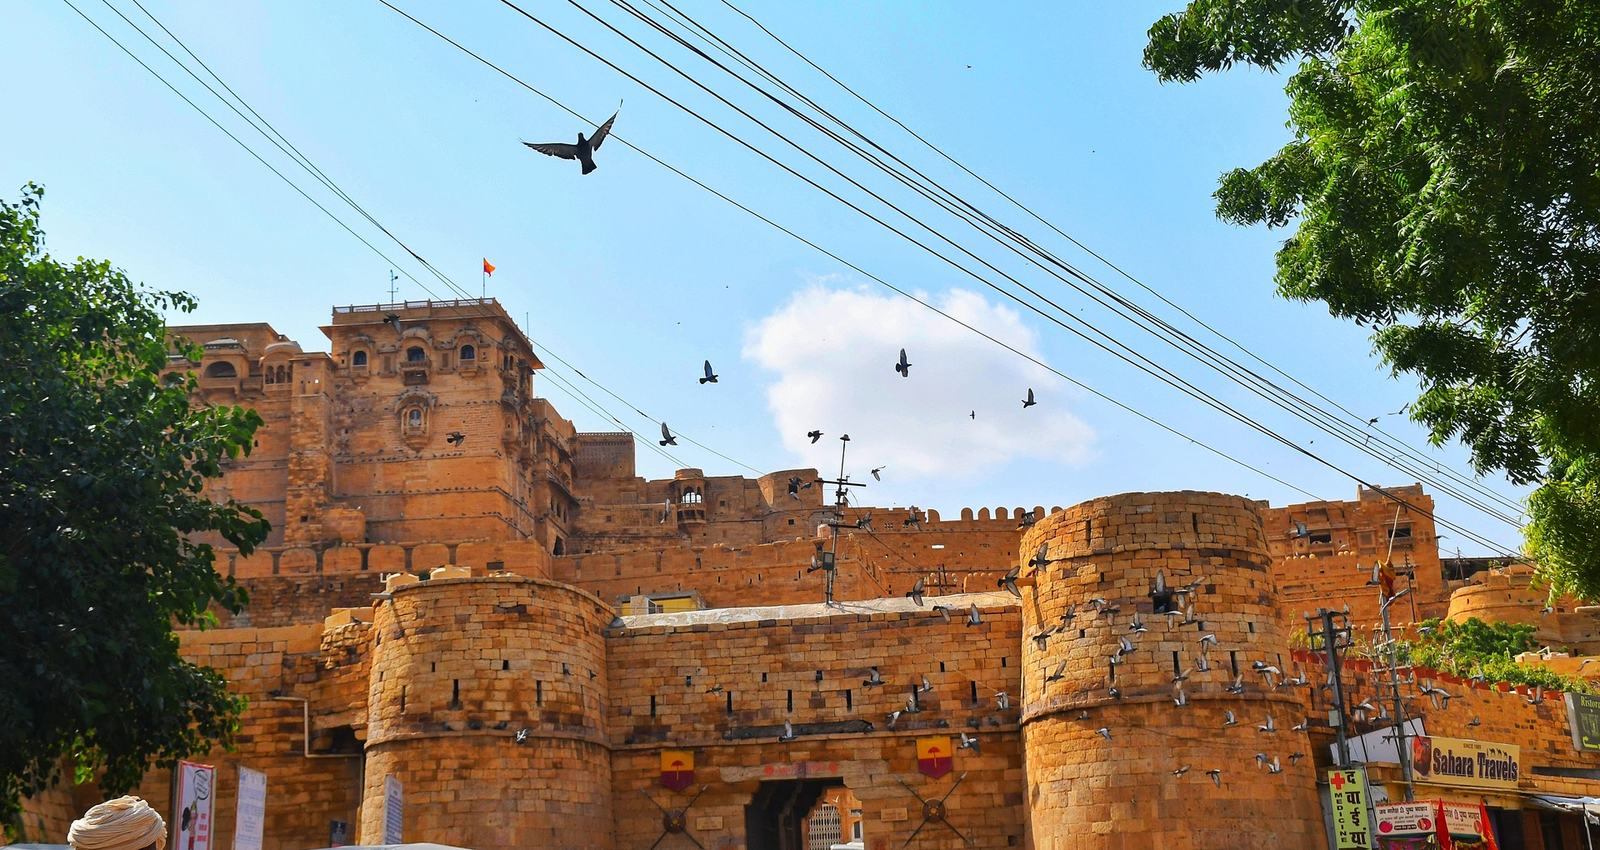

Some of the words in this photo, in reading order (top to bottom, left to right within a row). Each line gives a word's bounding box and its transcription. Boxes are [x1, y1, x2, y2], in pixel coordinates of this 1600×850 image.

[1432, 747, 1474, 777] Sahara
[1477, 751, 1518, 782] Travels
[1334, 792, 1347, 843] MEDICINE
